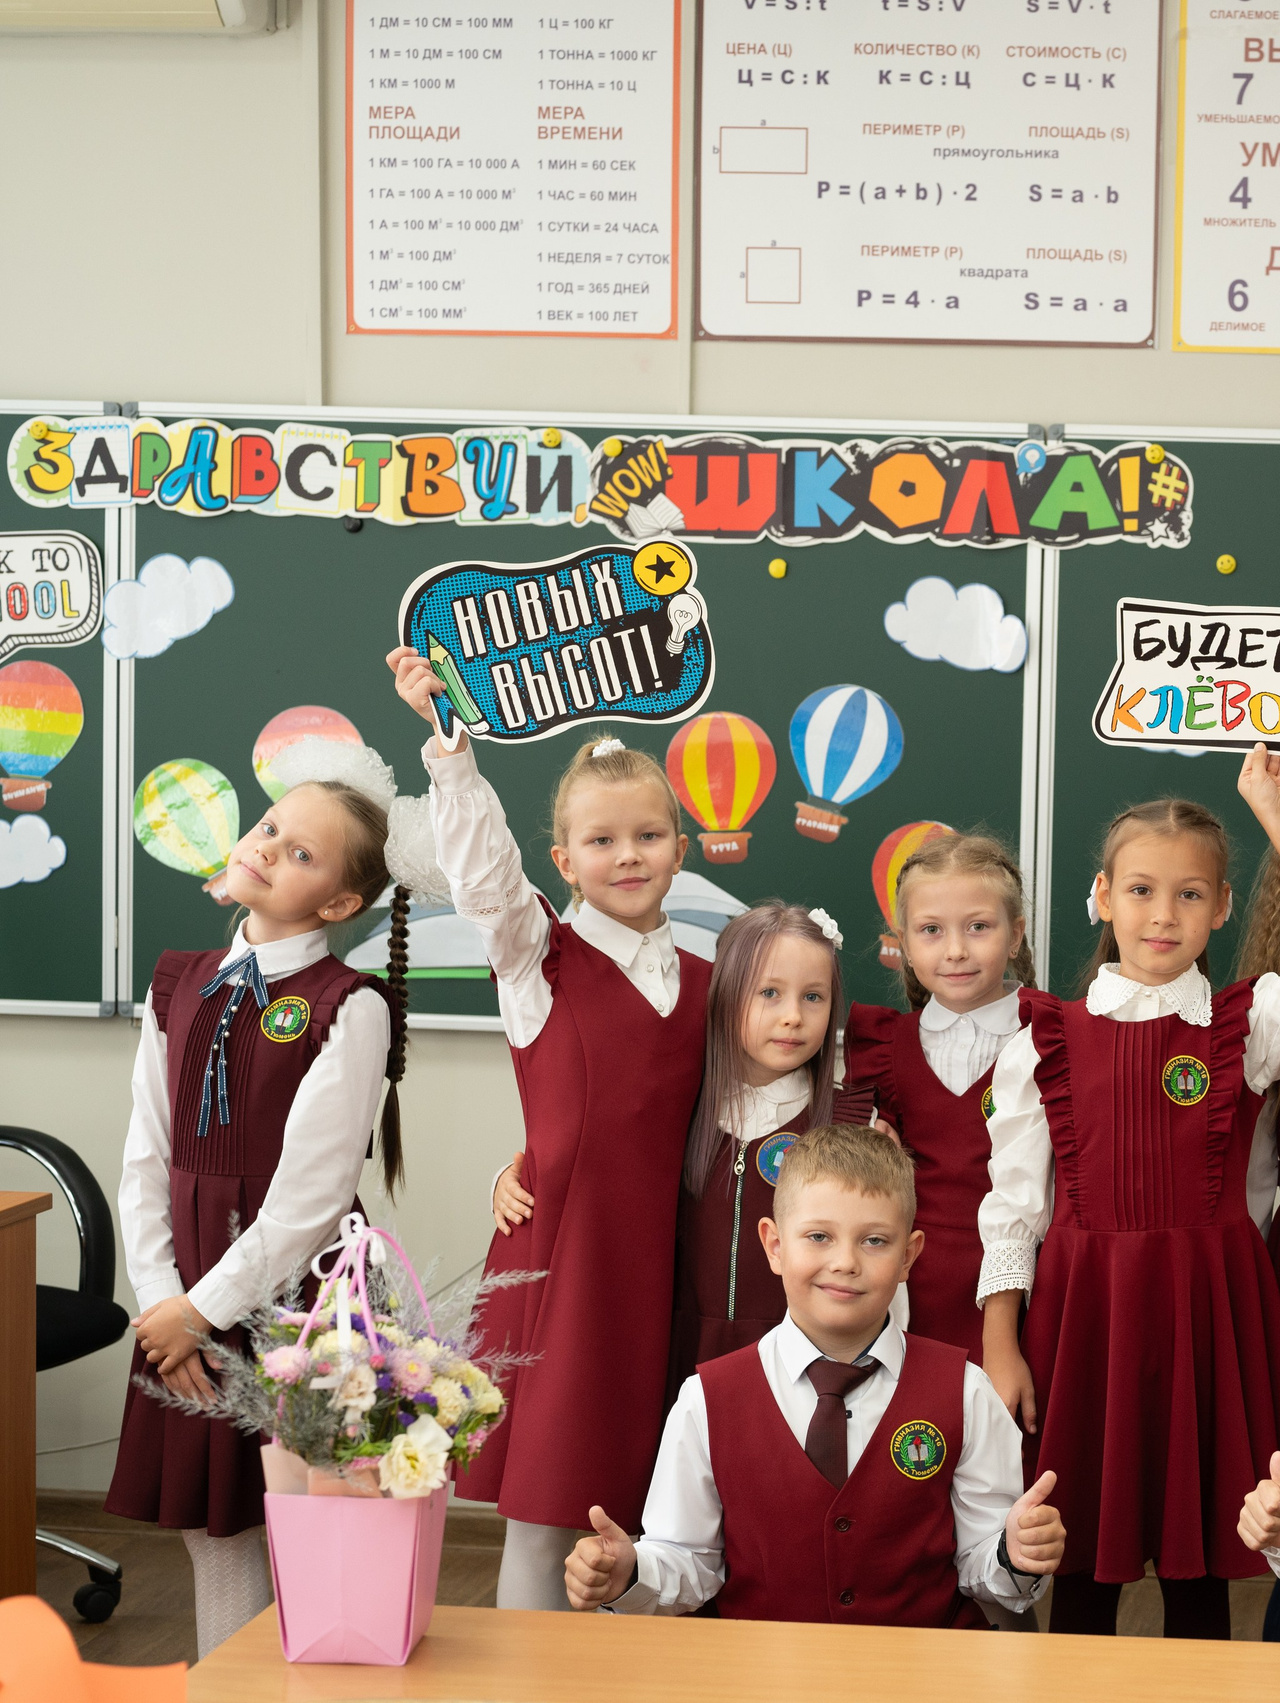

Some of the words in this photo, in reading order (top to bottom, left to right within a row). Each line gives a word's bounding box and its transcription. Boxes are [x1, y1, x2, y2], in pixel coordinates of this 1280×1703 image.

[1210, 10, 1279, 20] СЛАГАЕМОЕ
[539, 50, 543, 59] 1
[549, 50, 594, 60] ТОННА
[610, 50, 638, 61] 1000
[642, 51, 657, 61] КГ
[726, 43, 767, 56] ЦЕНА
[772, 43, 792, 57] (Ц)
[854, 43, 957, 56] КОЛИЧЕСТВО
[962, 45, 980, 59] (К)
[1006, 46, 1101, 58] СТОИМОСТЬ
[1106, 47, 1127, 62] (С)
[369, 79, 374, 88] 1
[380, 78, 397, 88] КМ
[413, 79, 441, 89] 1000
[446, 79, 455, 88] М
[1233, 73, 1254, 105] 7
[369, 106, 415, 119] МЕРА
[538, 106, 585, 119] МЕРА
[369, 126, 460, 142] ПЛОЩАДИ
[538, 126, 622, 140] ВРЕМЕНИ
[863, 124, 942, 135] ПЕРИМЕТР
[1029, 126, 1106, 140] ПЛОЩАДЬ
[1111, 127, 1129, 141] (S)
[933, 148, 1059, 160] прямоугольника
[538, 160, 542, 169] 1
[548, 160, 576, 169] МИН
[592, 160, 606, 170] 60
[610, 160, 635, 171] СЕК
[1229, 177, 1252, 209] 4
[538, 222, 542, 231] 1
[548, 221, 589, 232] СУТКИ
[605, 222, 618, 232] 24
[623, 223, 658, 233] ЧАСА
[1204, 217, 1276, 227] МНОЖИТЕЛЬ
[861, 245, 939, 257] ПЕРИМЕТР
[1027, 248, 1103, 262] ПЛОЩАДЬ
[1108, 250, 1127, 263] (S)
[537, 252, 542, 262] 1
[548, 252, 601, 264] НЕДЕЛЯ
[617, 253, 623, 263] 7
[627, 253, 670, 265] СУТОК
[960, 268, 1028, 280] квадрата
[537, 282, 542, 292] 1
[548, 282, 573, 294] ГОД
[589, 283, 609, 293] 365
[613, 283, 649, 295] ДНЕЙ
[1228, 279, 1249, 312] 6
[537, 310, 542, 320] 1
[548, 310, 572, 320] ВЕК
[589, 311, 609, 321] 100
[613, 311, 638, 321] ЛЕТ
[1209, 322, 1265, 331] ДЕЛИМОЕ
[590, 438, 673, 519] WOW!
[667, 451, 1140, 535] ШКОЛА!
[32, 548, 69, 572] TO
[453, 560, 623, 659] НОВЫХ
[491, 625, 663, 729] ВЫСОТ!
[1165, 1058, 1194, 1080] ГИМНАЗИЯ
[764, 1136, 796, 1151] ГИМНАЗИ
[894, 1425, 926, 1452] ГИМНАЗИЯ
